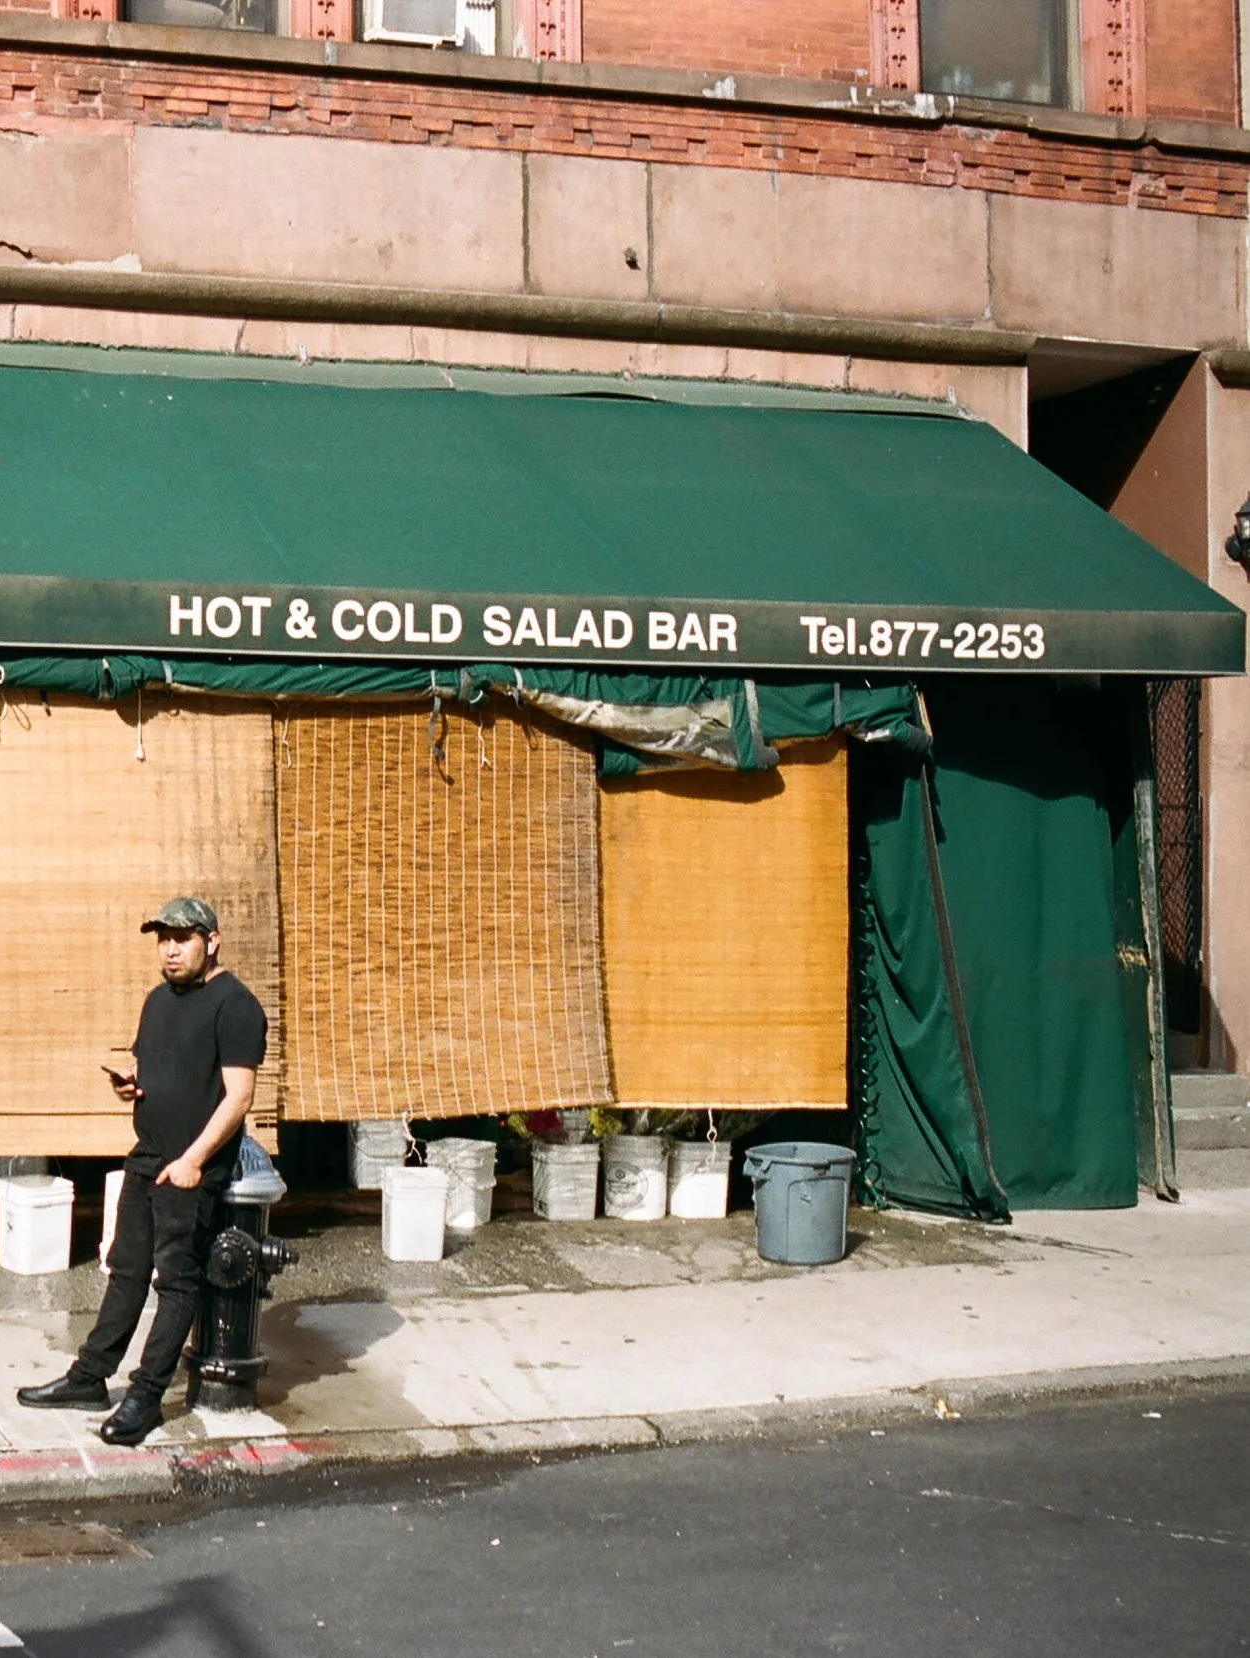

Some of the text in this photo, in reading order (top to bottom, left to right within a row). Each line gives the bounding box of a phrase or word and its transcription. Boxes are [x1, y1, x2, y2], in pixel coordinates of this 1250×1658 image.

[169, 594, 1046, 660] HOT & COLD SALAD BAR Tel.877-2253
